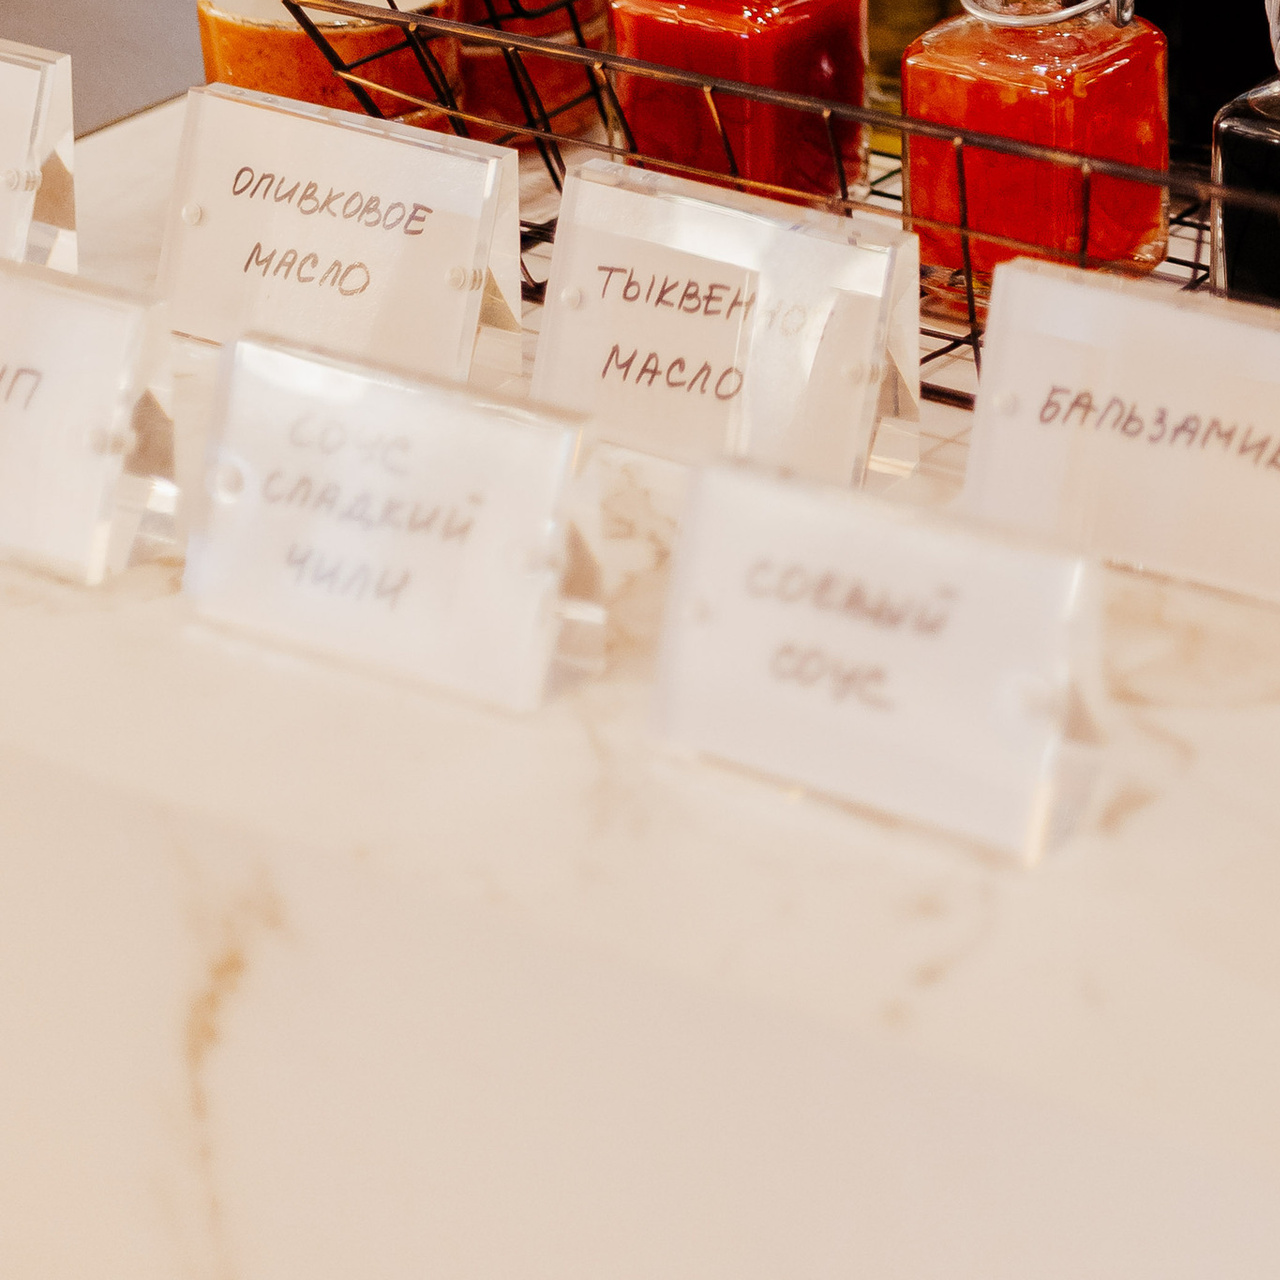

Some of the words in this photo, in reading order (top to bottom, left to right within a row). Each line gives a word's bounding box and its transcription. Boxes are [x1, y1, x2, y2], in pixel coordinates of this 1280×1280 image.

[243, 241, 371, 297] МАСЛО
[601, 343, 744, 401] МАСЛО
[261, 466, 487, 546] СЛАДКИЙ
[284, 541, 415, 612] ЧИЛИ
